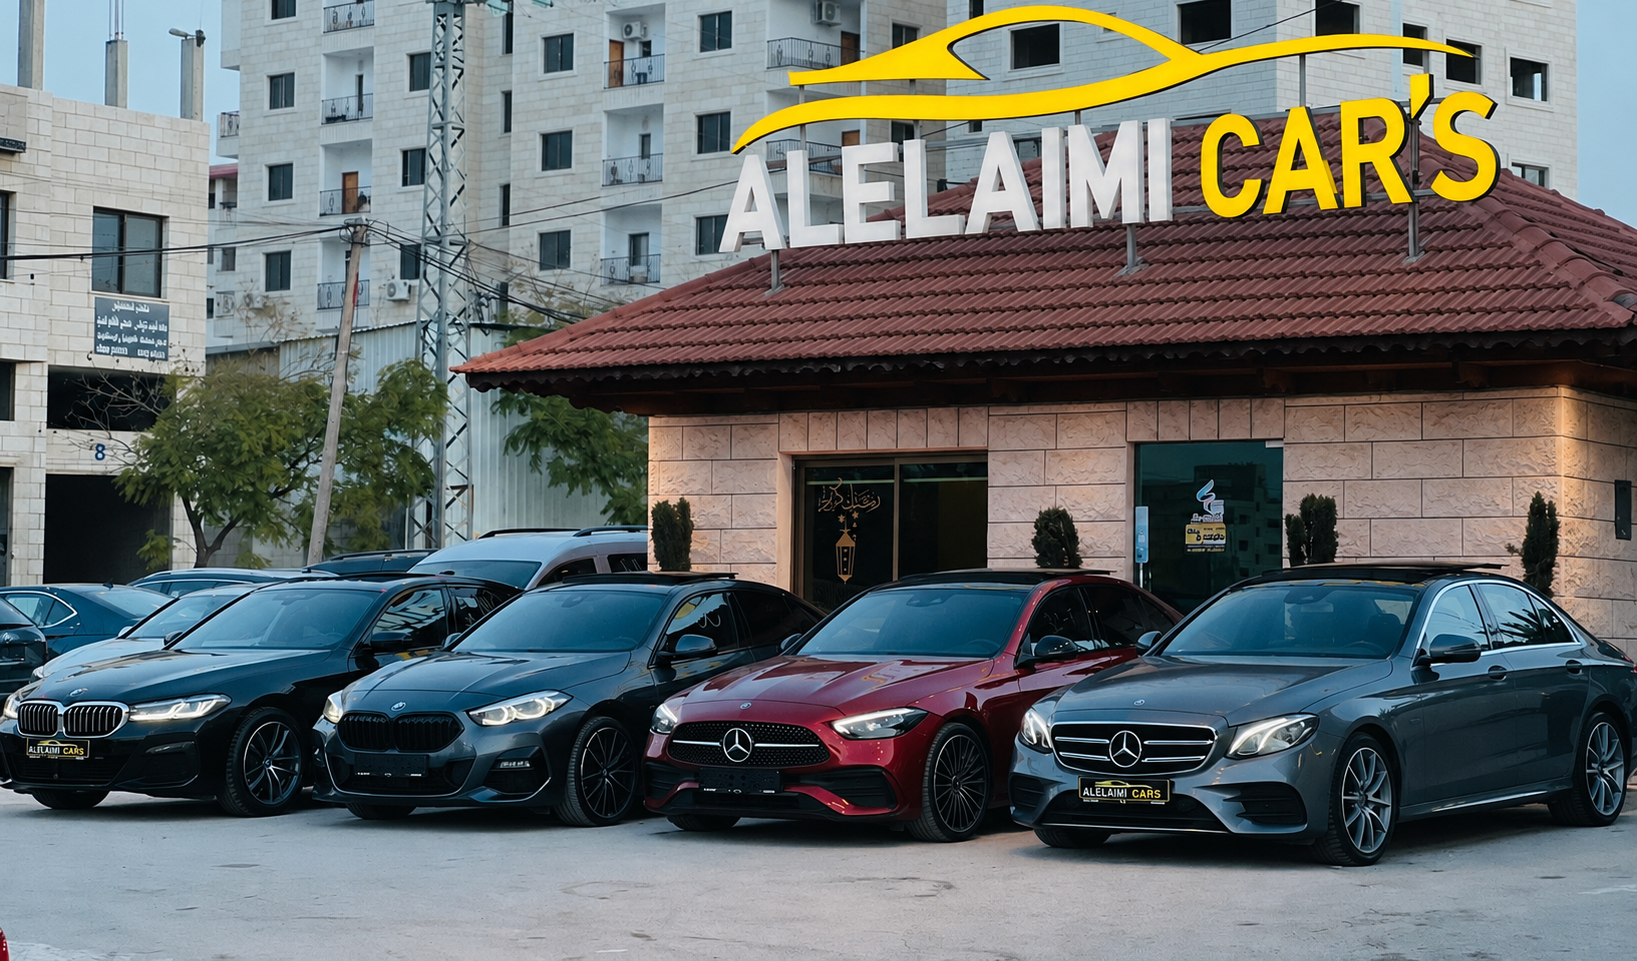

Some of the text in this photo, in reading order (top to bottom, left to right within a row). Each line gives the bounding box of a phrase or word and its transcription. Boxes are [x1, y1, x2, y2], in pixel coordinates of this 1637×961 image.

[718, 73, 1501, 253] ALELAIMI CAR'S
[95, 443, 106, 461] 8
[63, 747, 84, 755] CARS
[1082, 787, 1161, 799] ALELAIMI CARS
